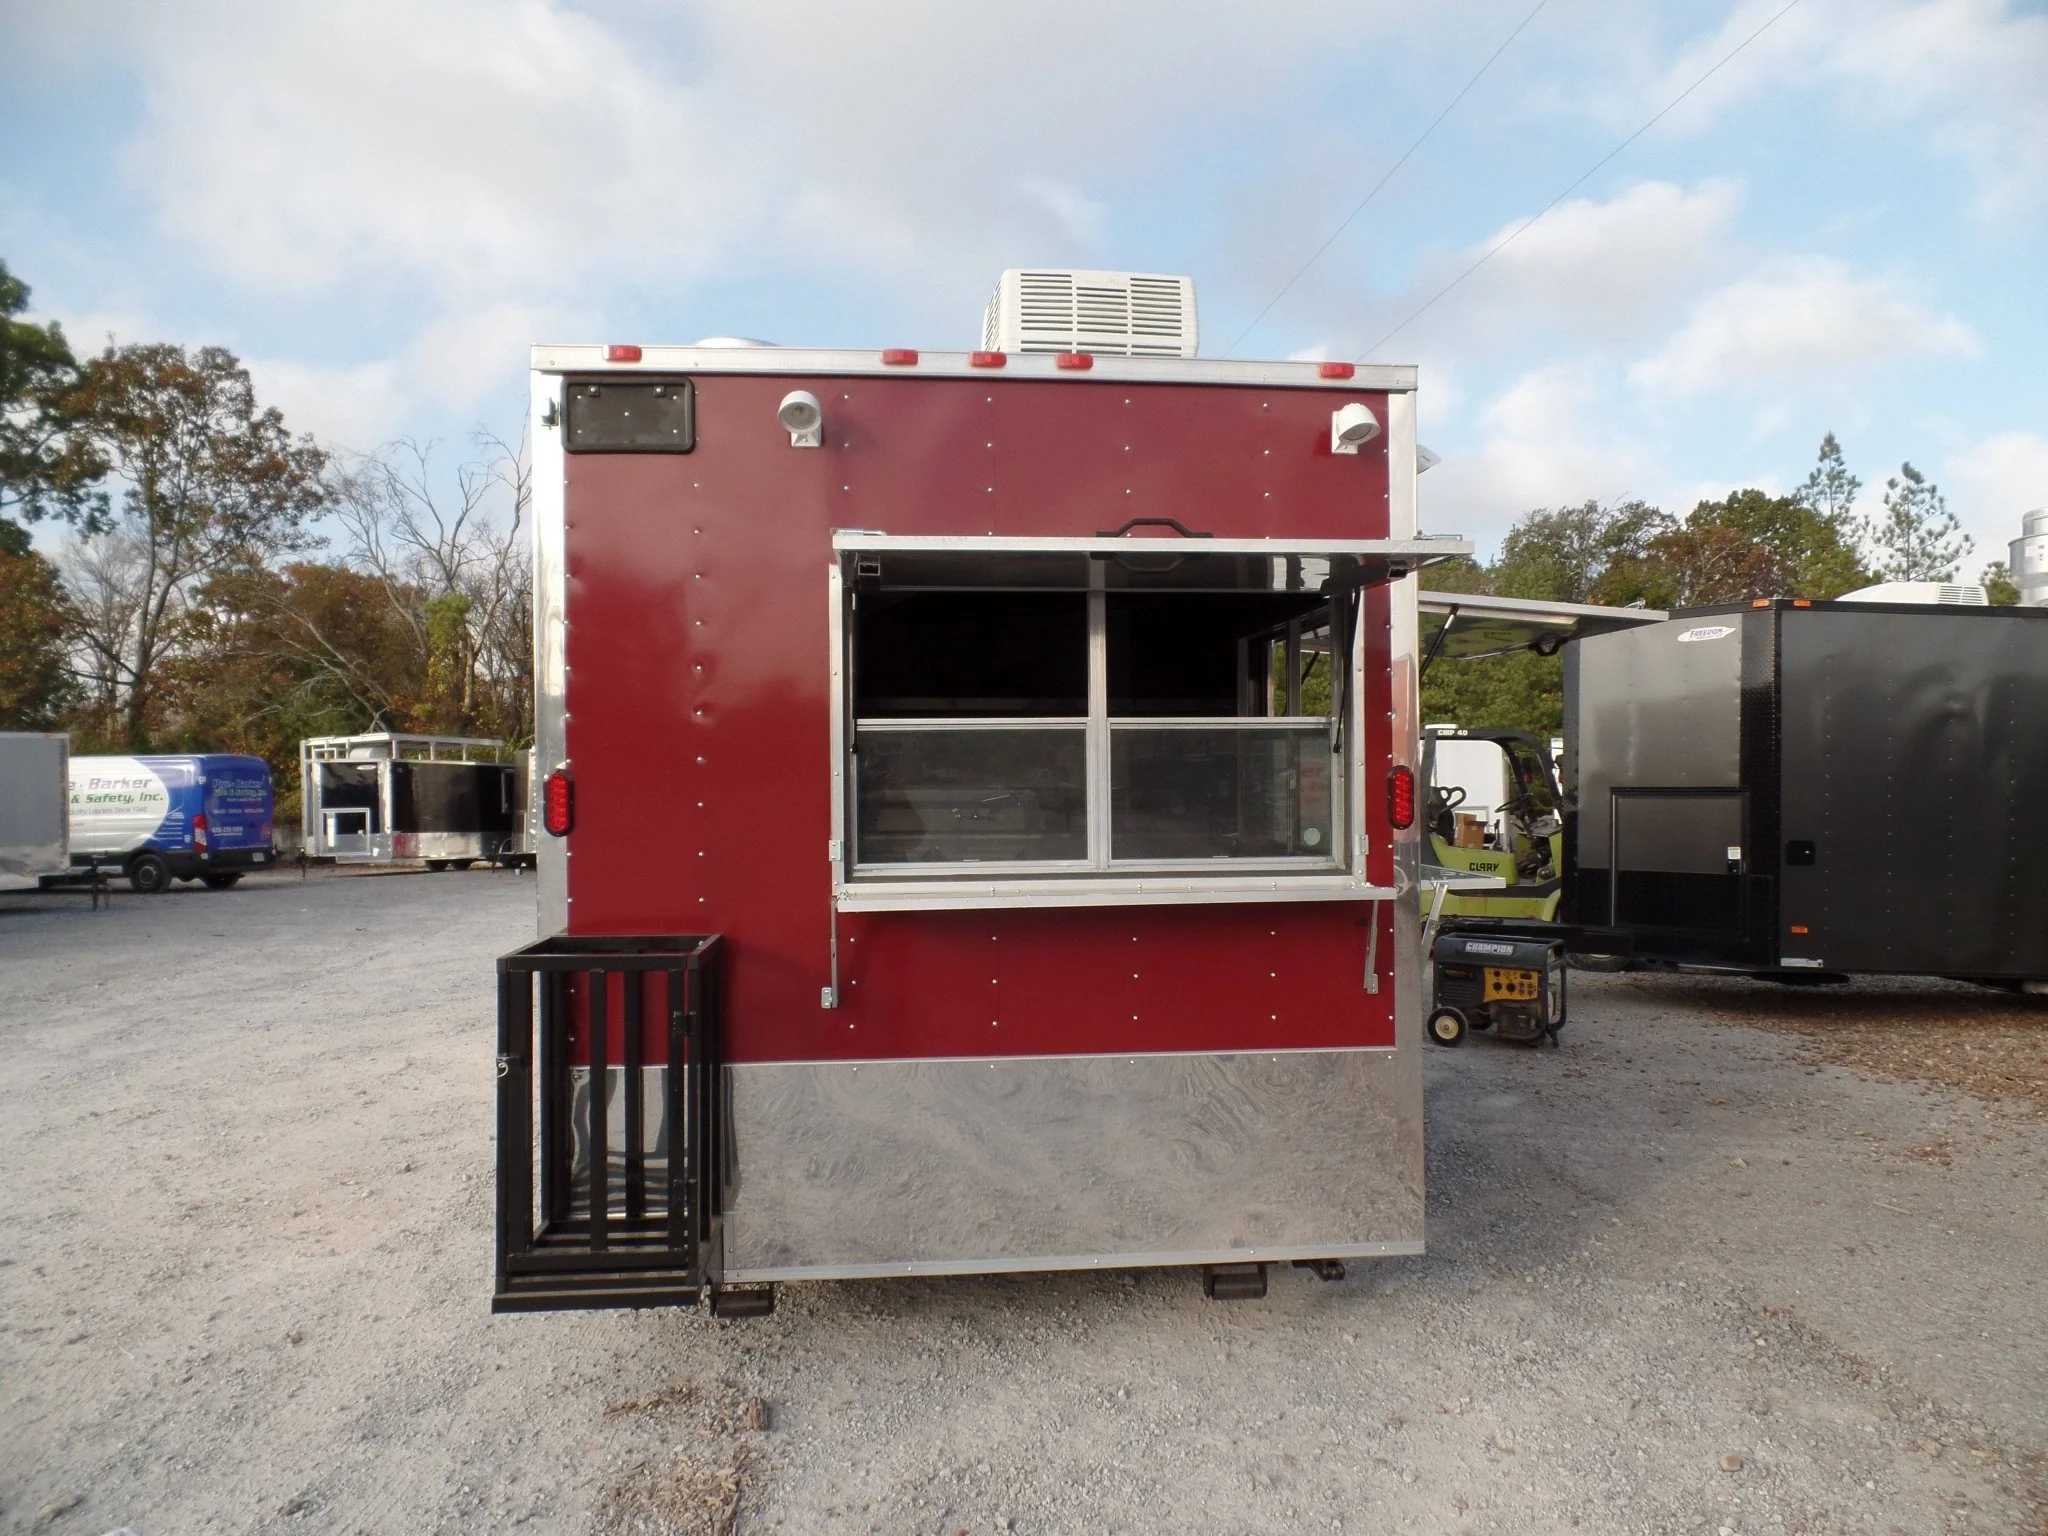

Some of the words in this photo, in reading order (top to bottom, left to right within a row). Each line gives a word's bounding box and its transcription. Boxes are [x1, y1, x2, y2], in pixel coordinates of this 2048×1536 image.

[1690, 628, 1723, 639] FREEDOM
[88, 777, 152, 790] Barker
[86, 793, 134, 804] Safety,
[140, 792, 164, 802] Inc.
[1469, 862, 1500, 872] CLARK
[1465, 942, 1515, 955] CHAMPION
